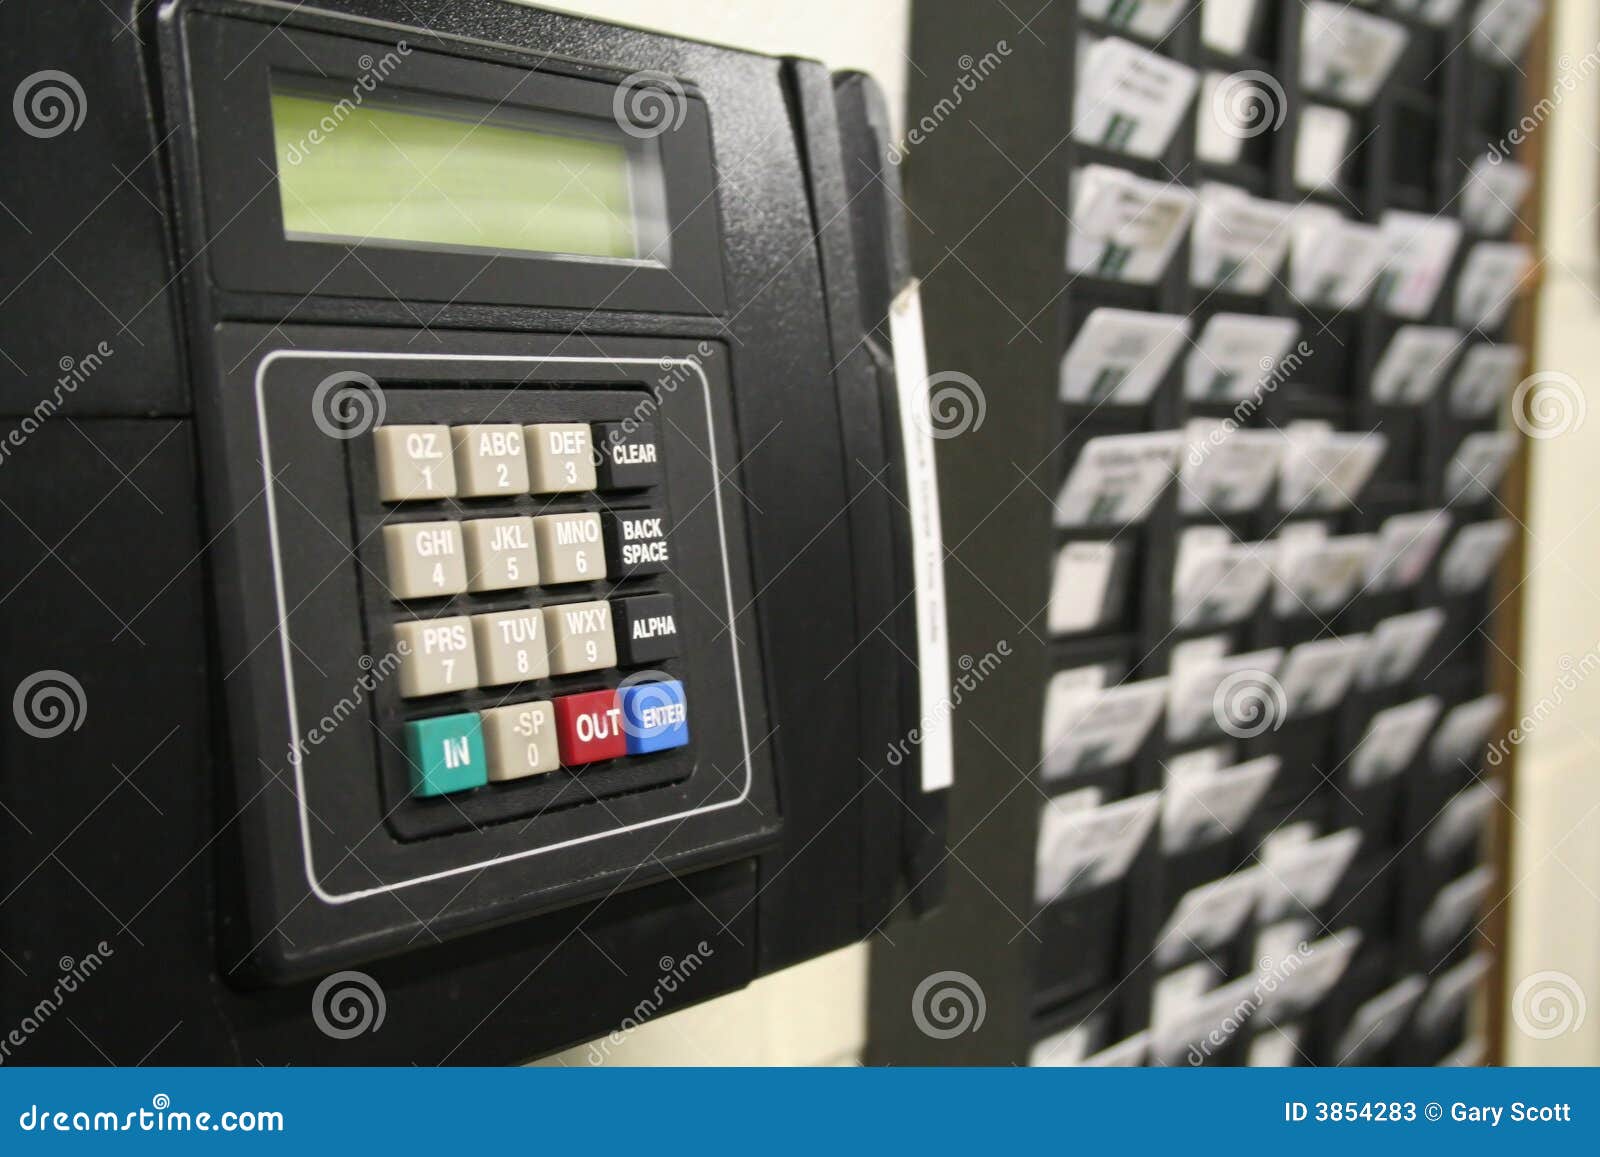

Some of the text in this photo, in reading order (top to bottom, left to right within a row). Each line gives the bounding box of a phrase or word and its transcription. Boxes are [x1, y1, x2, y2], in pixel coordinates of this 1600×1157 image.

[479, 432, 521, 457] ABC
[550, 431, 586, 455] DEF
[612, 443, 656, 465] CLEAR
[422, 467, 434, 490] 1
[496, 464, 510, 487] 2
[565, 462, 578, 484] 3
[491, 525, 529, 550] JKL
[556, 519, 599, 544] MNO
[623, 518, 663, 540] BACK
[416, 530, 455, 557] GHI
[623, 542, 669, 565] SPACE
[507, 557, 519, 581] 5
[575, 551, 588, 574] 6
[432, 564, 446, 588] 4
[499, 617, 538, 644] TUV
[566, 608, 607, 634] WXY
[632, 615, 677, 640] ALPHA
[422, 625, 468, 654] PRS
[585, 640, 597, 663] 9
[441, 659, 455, 684] 7
[516, 649, 530, 674] 8
[576, 709, 621, 742] OUT
[643, 703, 686, 729] ENTER
[443, 736, 471, 769] IN
[527, 743, 540, 767] 0
